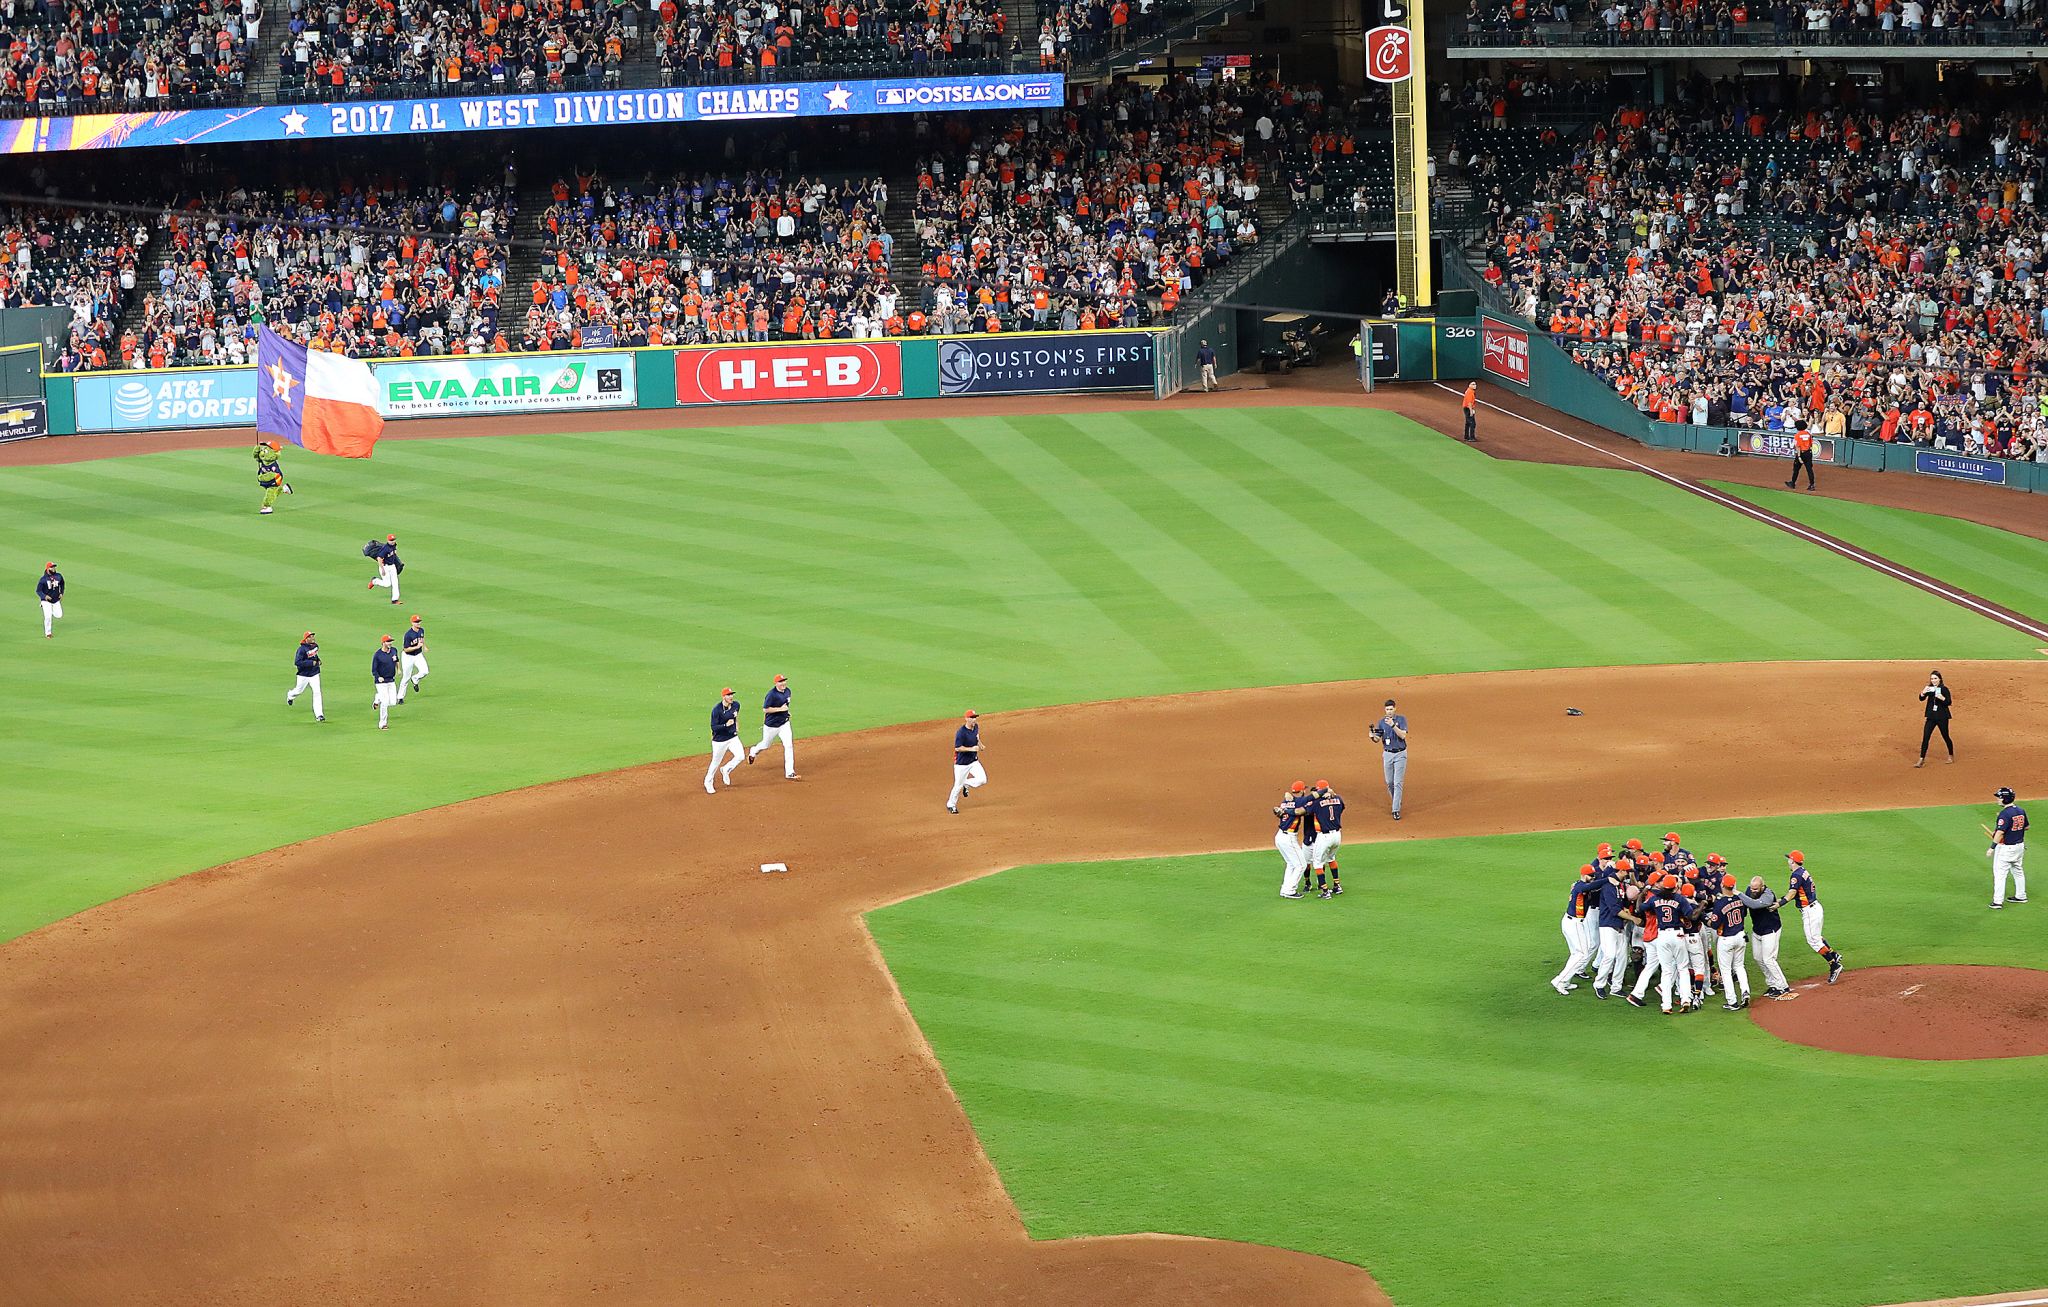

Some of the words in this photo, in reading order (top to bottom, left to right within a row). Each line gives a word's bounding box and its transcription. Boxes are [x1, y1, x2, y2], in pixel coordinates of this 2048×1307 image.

[904, 83, 1026, 104] POSTSEASON
[1026, 86, 1052, 97] 2017
[331, 104, 393, 134] 2017
[410, 103, 446, 130] AL
[460, 99, 539, 128] WEST
[554, 92, 685, 124] DIVISION
[697, 88, 799, 115] CHAMPS
[583, 336, 604, 344] EARNED
[591, 328, 602, 337] WE
[1445, 326, 1476, 338] 326
[961, 348, 1085, 369] HOUSTON'S
[1097, 346, 1152, 363] FIRST
[1507, 353, 1516, 369] FOR
[719, 355, 863, 391] H-E-B
[961, 370, 1035, 381] BAPTIST
[1049, 366, 1116, 377] CHURCH
[156, 379, 215, 400] AT&T
[389, 379, 467, 402] EVA
[471, 375, 541, 398] AIR
[586, 393, 622, 401] Pacific
[0, 425, 38, 438] HEVROLET
[1937, 458, 1955, 468] TEXAS
[1958, 462, 1984, 472] LOTTERY
[1329, 806, 1335, 821] 1
[1661, 906, 1673, 923] 3
[1726, 908, 1742, 928] 10
